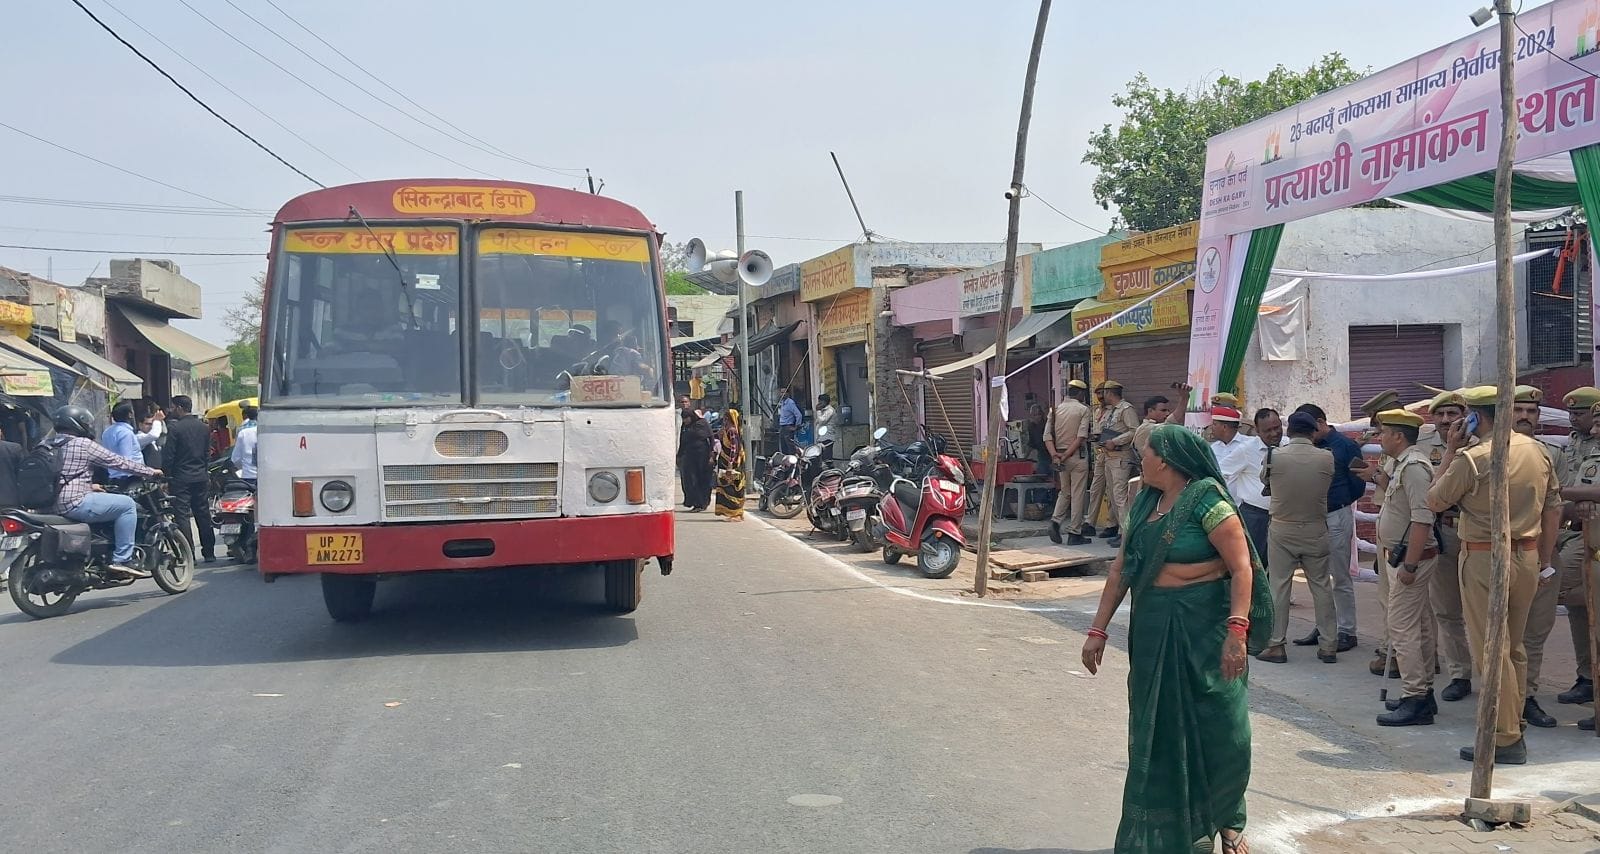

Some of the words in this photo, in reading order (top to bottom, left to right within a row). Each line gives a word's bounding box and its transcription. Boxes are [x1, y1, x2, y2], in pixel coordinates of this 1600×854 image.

[1289, 106, 1335, 143] 23-बदायूँ
[1337, 91, 1391, 126] लोकसभा
[1396, 69, 1447, 105] सामान्य
[1265, 142, 1352, 212] प्रत्याशी
[1361, 109, 1489, 182] नामांकन
[1209, 177, 1226, 196] चुनाव
[1227, 173, 1236, 186] का
[398, 188, 486, 209] सिकन्द्राबाद
[489, 190, 527, 209] डिपो
[350, 231, 396, 251] उत्तर
[404, 228, 457, 251] प्रदेश
[1111, 266, 1152, 297] कृष्णा
[299, 435, 308, 450] A
[319, 535, 335, 548] UP
[342, 535, 357, 548] 77
